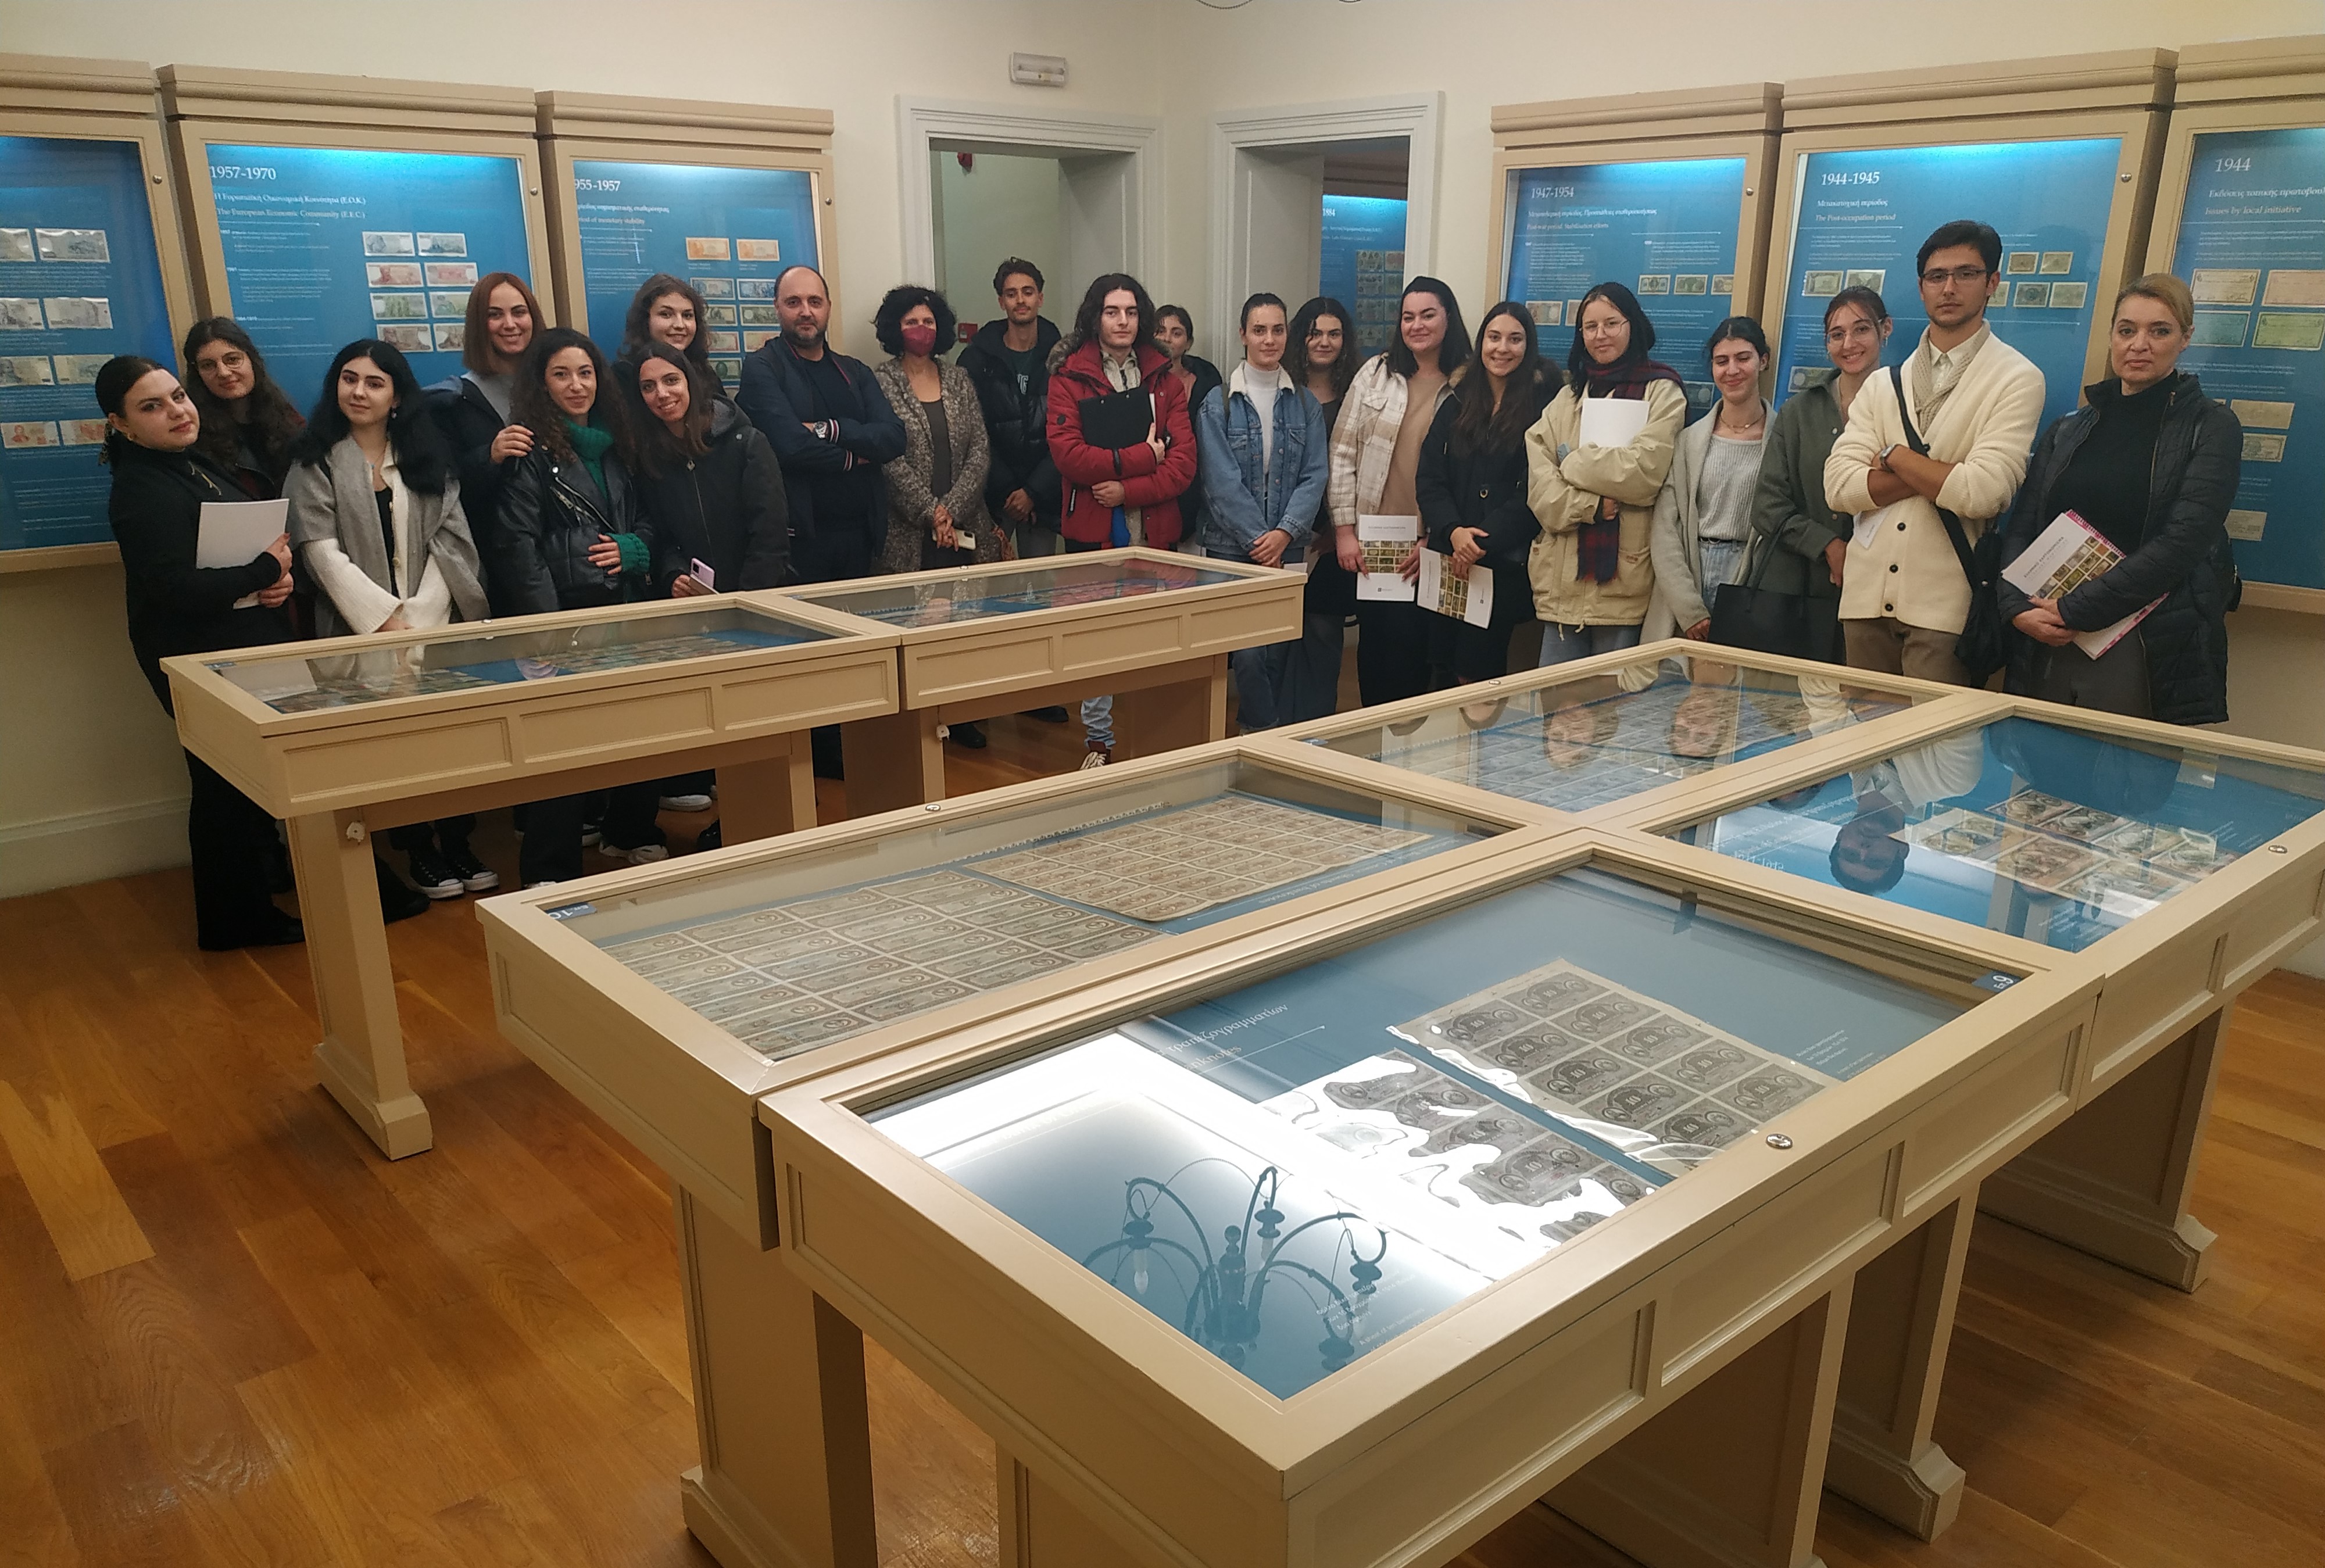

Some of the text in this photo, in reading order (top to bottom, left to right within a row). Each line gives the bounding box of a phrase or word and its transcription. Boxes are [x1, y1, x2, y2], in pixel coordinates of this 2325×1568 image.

[2215, 157, 2251, 172] 1944
[210, 166, 277, 180] 1957-1970
[1821, 171, 1880, 185] 1944-1945
[574, 179, 621, 192] 955-1957
[1531, 187, 1575, 198] 1947-1954
[1189, 1046, 1242, 1069] nknotes
[1570, 1069, 1586, 1078] 10
[1625, 1095, 1641, 1105] 10
[1683, 1123, 1699, 1133] 10
